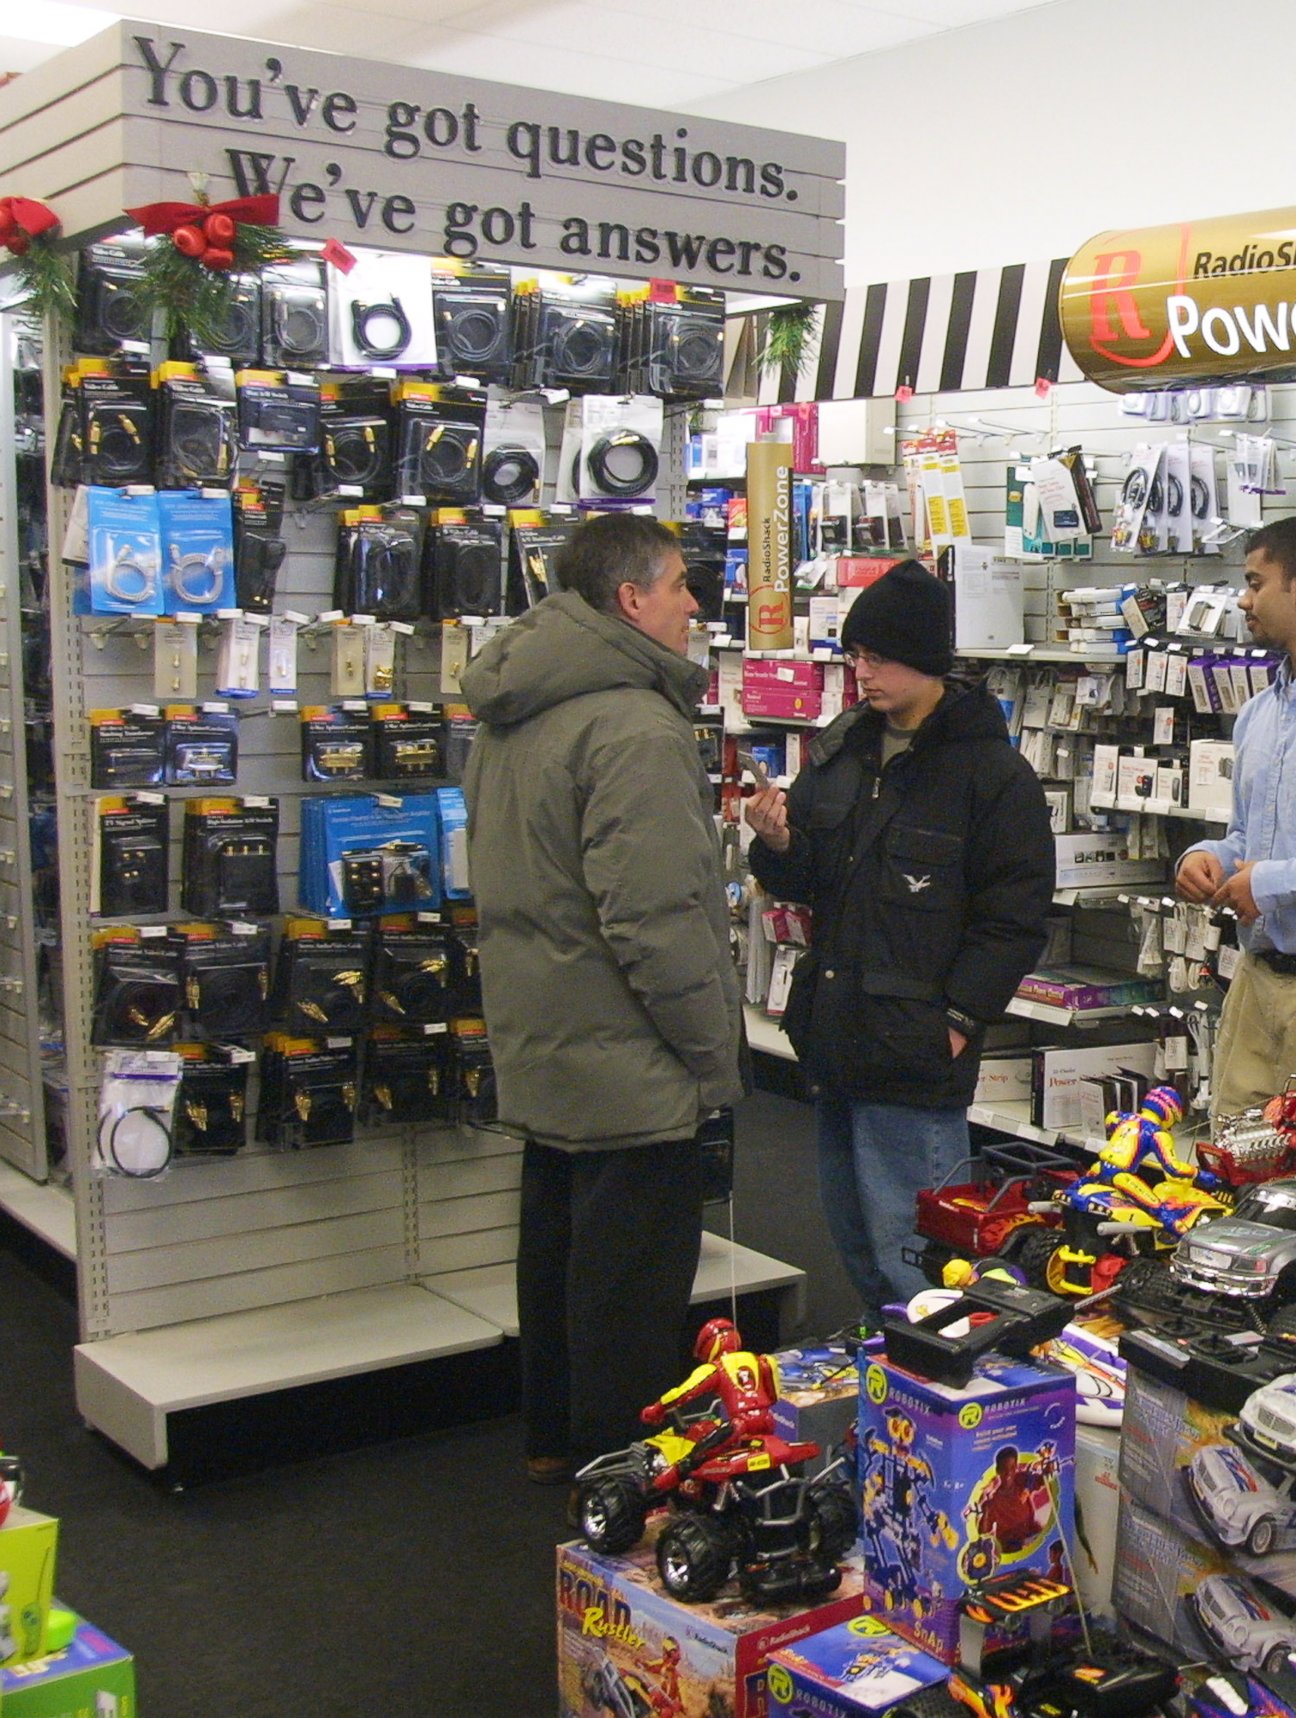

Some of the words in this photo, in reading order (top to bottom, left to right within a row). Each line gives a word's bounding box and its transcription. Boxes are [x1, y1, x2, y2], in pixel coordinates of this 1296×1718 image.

[133, 36, 357, 133] You've
[385, 101, 482, 159] got
[507, 128, 798, 201] questions.
[225, 149, 416, 233] We've
[443, 202, 536, 259] got
[560, 218, 800, 282] answers.
[1089, 251, 1150, 341] R
[762, 516, 772, 584] RadioShack
[773, 465, 790, 594] PowerZone
[758, 601, 784, 628] R
[1049, 1077, 1078, 1088] Power
[582, 1606, 646, 1652] Rustler
